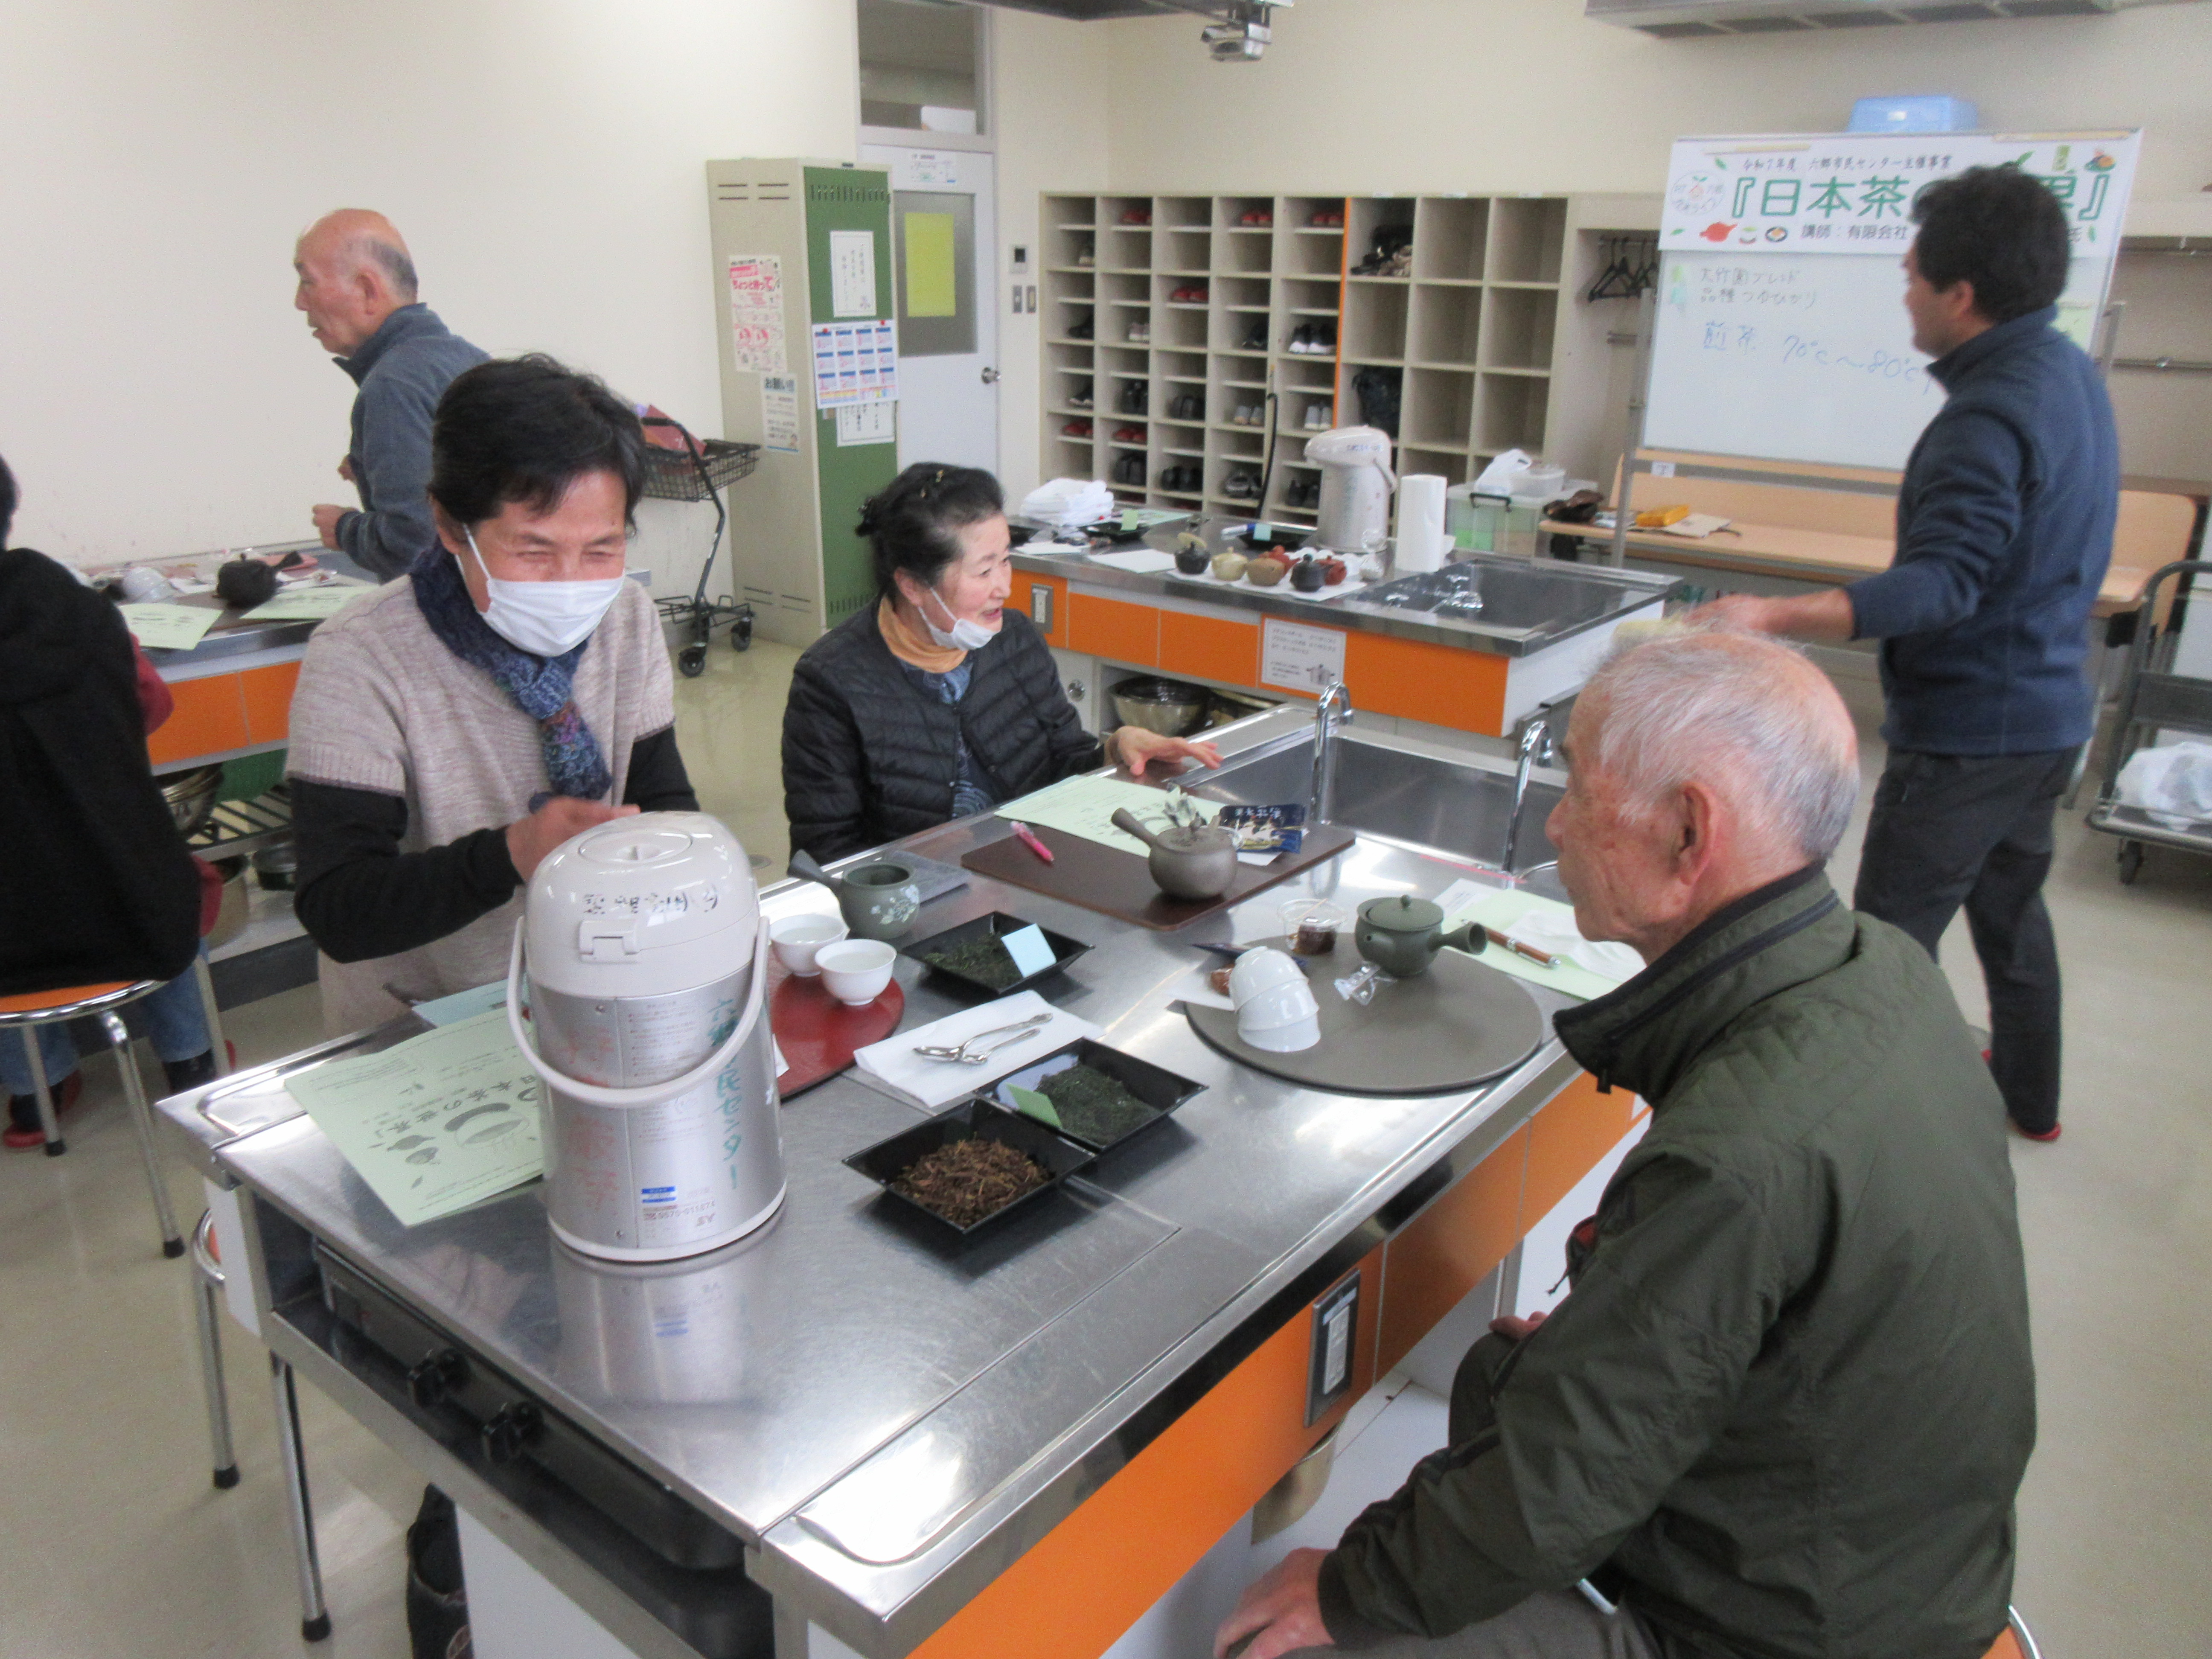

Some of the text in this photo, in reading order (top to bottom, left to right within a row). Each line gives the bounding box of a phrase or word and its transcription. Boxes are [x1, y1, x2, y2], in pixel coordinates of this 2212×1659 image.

[1732, 174, 2110, 221] 『日本茶』
[707, 998, 743, 1190] 六郷民センター
